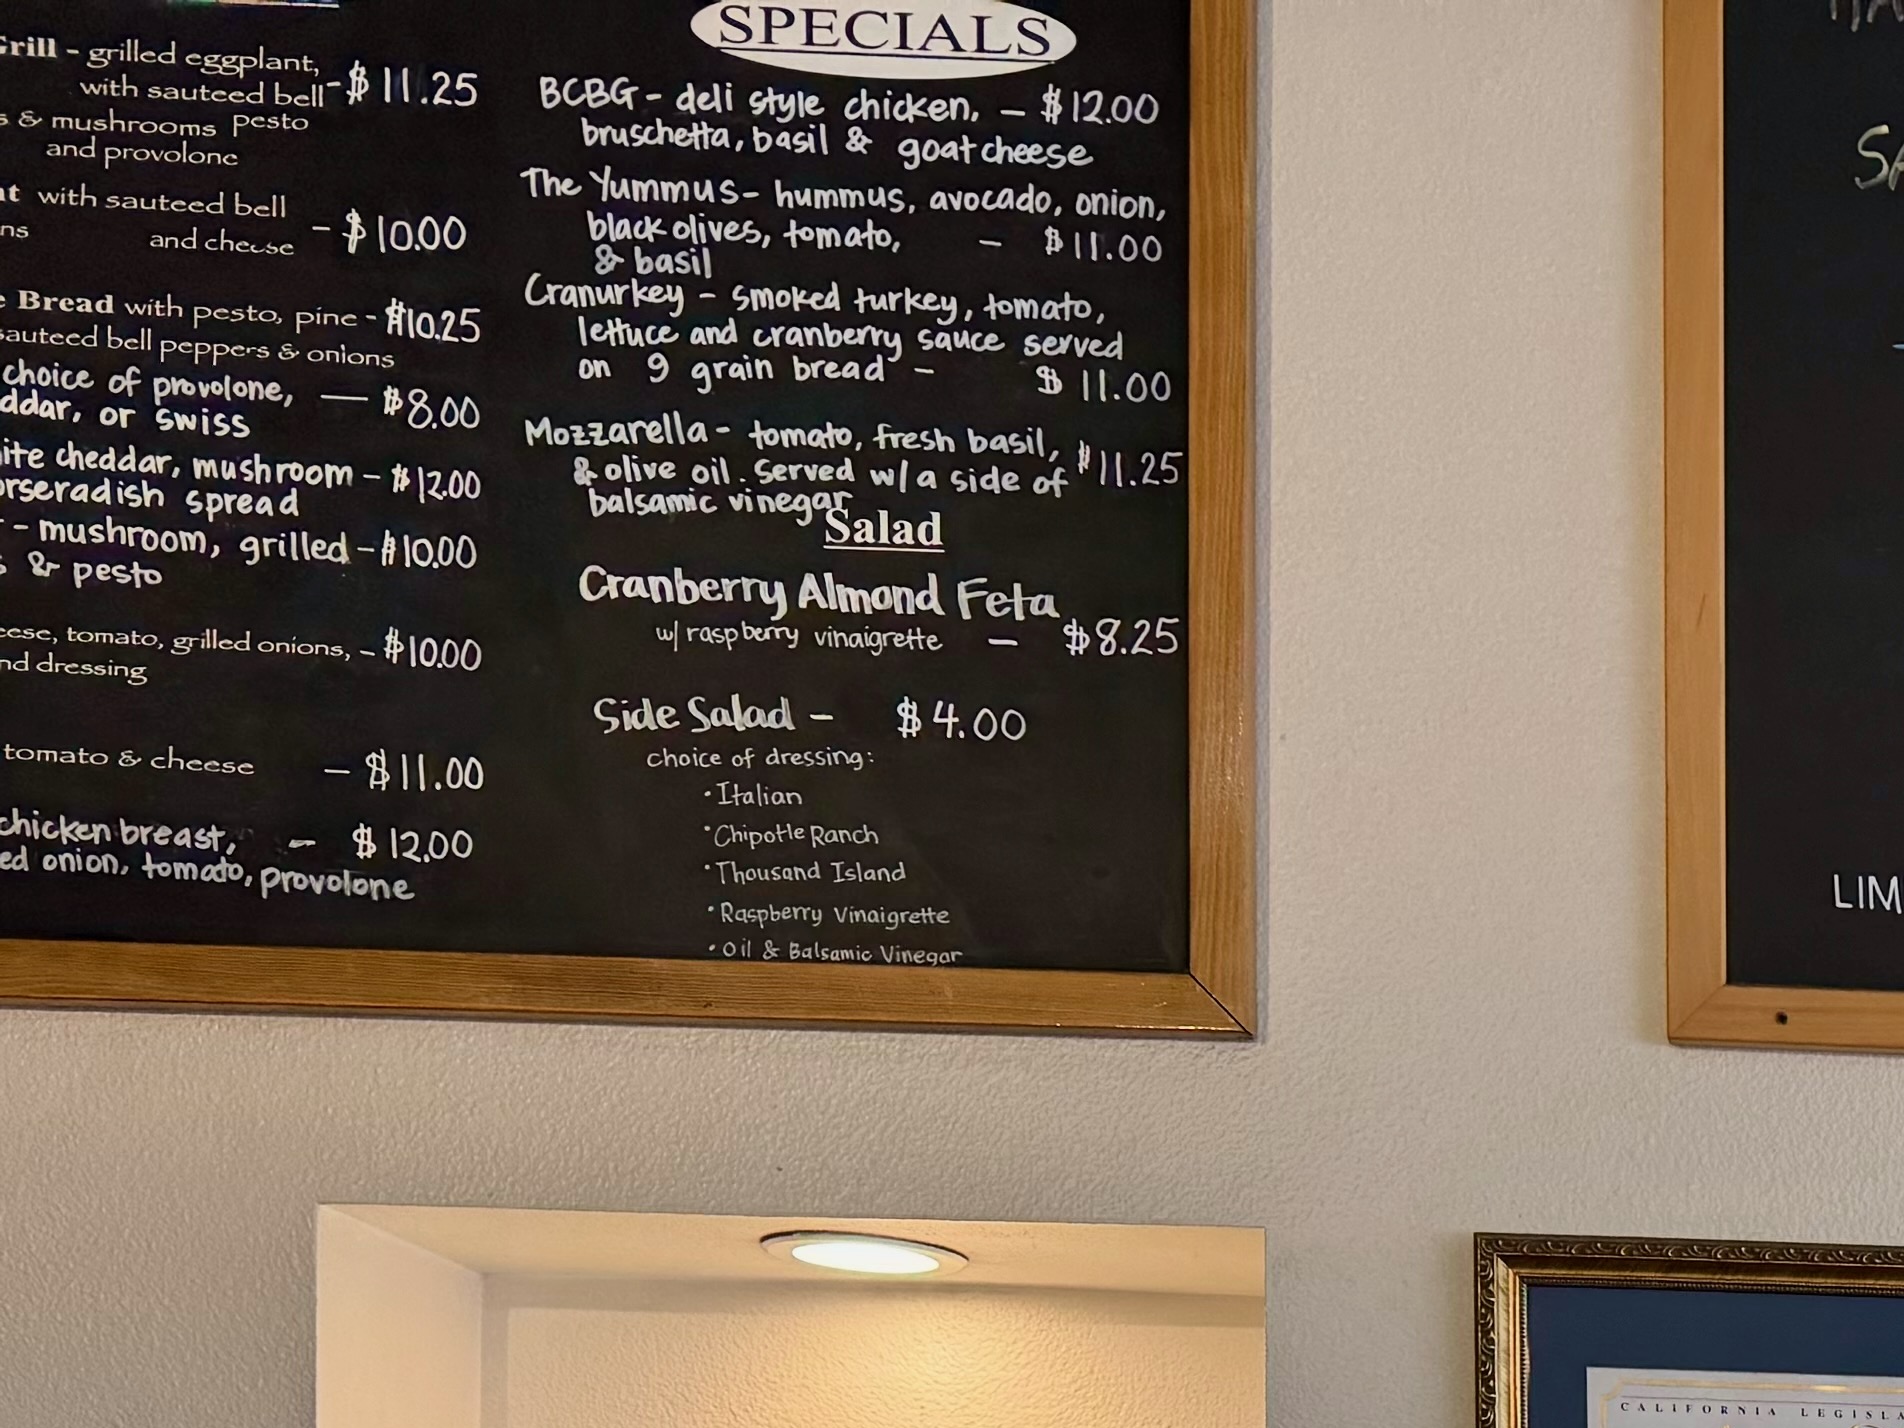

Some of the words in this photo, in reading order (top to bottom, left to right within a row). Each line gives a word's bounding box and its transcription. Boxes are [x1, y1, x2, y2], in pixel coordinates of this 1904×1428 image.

[717, 3, 1053, 59] SPECIALS
[87, 39, 175, 68] grilled
[185, 46, 319, 79] eggplant,
[80, 74, 138, 97] with
[148, 81, 264, 104] sauteed
[275, 82, 323, 107] bell
[540, 77, 639, 110] BCBG
[676, 83, 732, 114] deli
[749, 87, 824, 123] style
[581, 117, 743, 152] bruschetta,
[753, 123, 828, 155] basil
[898, 135, 977, 170] goat
[981, 135, 1093, 169] cheese
[520, 167, 582, 197] The
[775, 180, 915, 214] hummus,
[930, 183, 1061, 216] avocado,
[1076, 193, 1165, 221] onion,
[587, 210, 667, 242] black
[673, 214, 770, 248] olives,
[783, 219, 900, 252] tomato,
[18, 290, 114, 313] Bread
[125, 294, 182, 317] with
[194, 305, 282, 328] pesto,
[296, 307, 357, 334] pine
[525, 273, 684, 317] Cranurkey
[732, 281, 840, 311] smoked
[854, 287, 972, 325] turkey,
[983, 292, 1104, 324] tomato,
[578, 316, 679, 347] lettuce
[690, 317, 737, 345] and
[753, 322, 902, 362] cranberry
[918, 329, 1005, 351] sauce
[1024, 331, 1122, 360] served
[3, 358, 94, 390] choice
[109, 366, 141, 397] of
[153, 375, 292, 407] provolone,
[691, 355, 773, 394] grain
[793, 354, 884, 381] bread
[100, 407, 136, 428] or
[156, 408, 250, 438] swiss
[525, 411, 708, 446] Mozzarella
[749, 420, 862, 451] tomato,
[873, 424, 955, 452] fresh
[967, 427, 1058, 462] basil,
[56, 441, 180, 478] cheddar,
[193, 453, 353, 488] mushroom
[605, 454, 676, 482] olive
[754, 457, 855, 484] Served
[951, 466, 1020, 494] side
[1033, 467, 1068, 498] of
[186, 488, 299, 522] spread
[589, 487, 717, 517] balsamic
[729, 488, 853, 531] vinegar
[40, 516, 219, 558] mushroom,
[240, 531, 350, 565] grilled
[823, 508, 945, 548] Salad
[74, 562, 162, 588] pesto
[579, 565, 787, 621] Cranberry
[799, 573, 945, 615] Almond
[958, 578, 1060, 621] Feta
[687, 621, 798, 650] raspberry
[815, 626, 943, 656] vinaigrette
[594, 698, 680, 734] Side
[688, 694, 796, 732] Salad
[4, 744, 108, 764] tomato
[151, 746, 254, 774] cheese
[647, 747, 721, 767] choice
[732, 748, 755, 768] of
[766, 747, 873, 770] dressing:
[716, 781, 802, 806] Italian
[715, 823, 805, 849] Chipotle
[810, 824, 878, 848] Ranch
[43, 853, 128, 875] onion,
[142, 852, 252, 887] tomato,
[261, 867, 415, 901] provolone
[716, 861, 821, 885] Thousand
[831, 862, 906, 882] Island
[721, 902, 822, 929] Raspberry
[834, 906, 950, 930] Vinaigrette
[723, 940, 751, 957] Oil
[790, 942, 872, 961] Balsamic
[880, 945, 962, 966] Vinegar
[1621, 1403, 1775, 1415] CALIFORNIA
